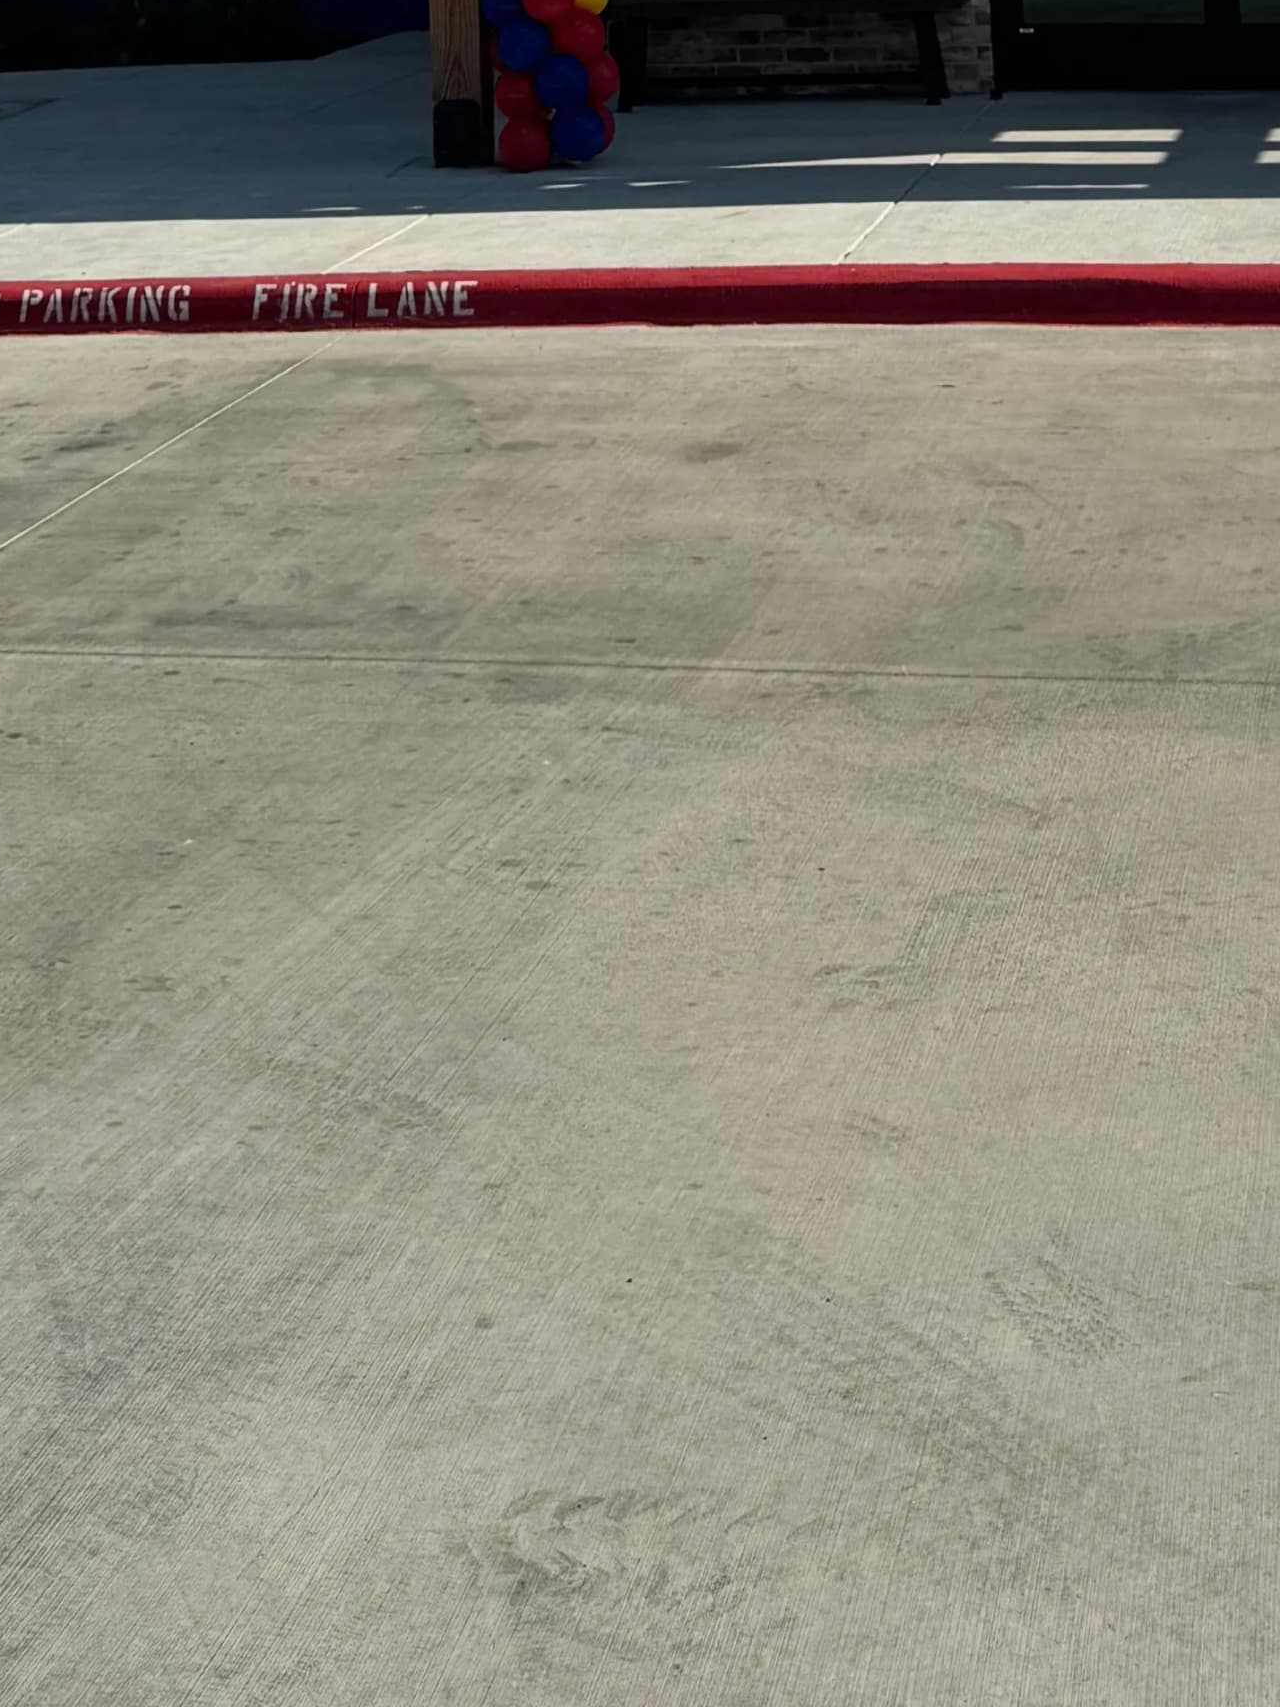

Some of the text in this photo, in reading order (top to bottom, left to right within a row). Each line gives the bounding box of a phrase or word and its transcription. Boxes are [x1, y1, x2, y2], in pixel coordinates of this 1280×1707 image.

[19, 283, 192, 325] PARKING
[251, 279, 480, 325] FIRE LANE
